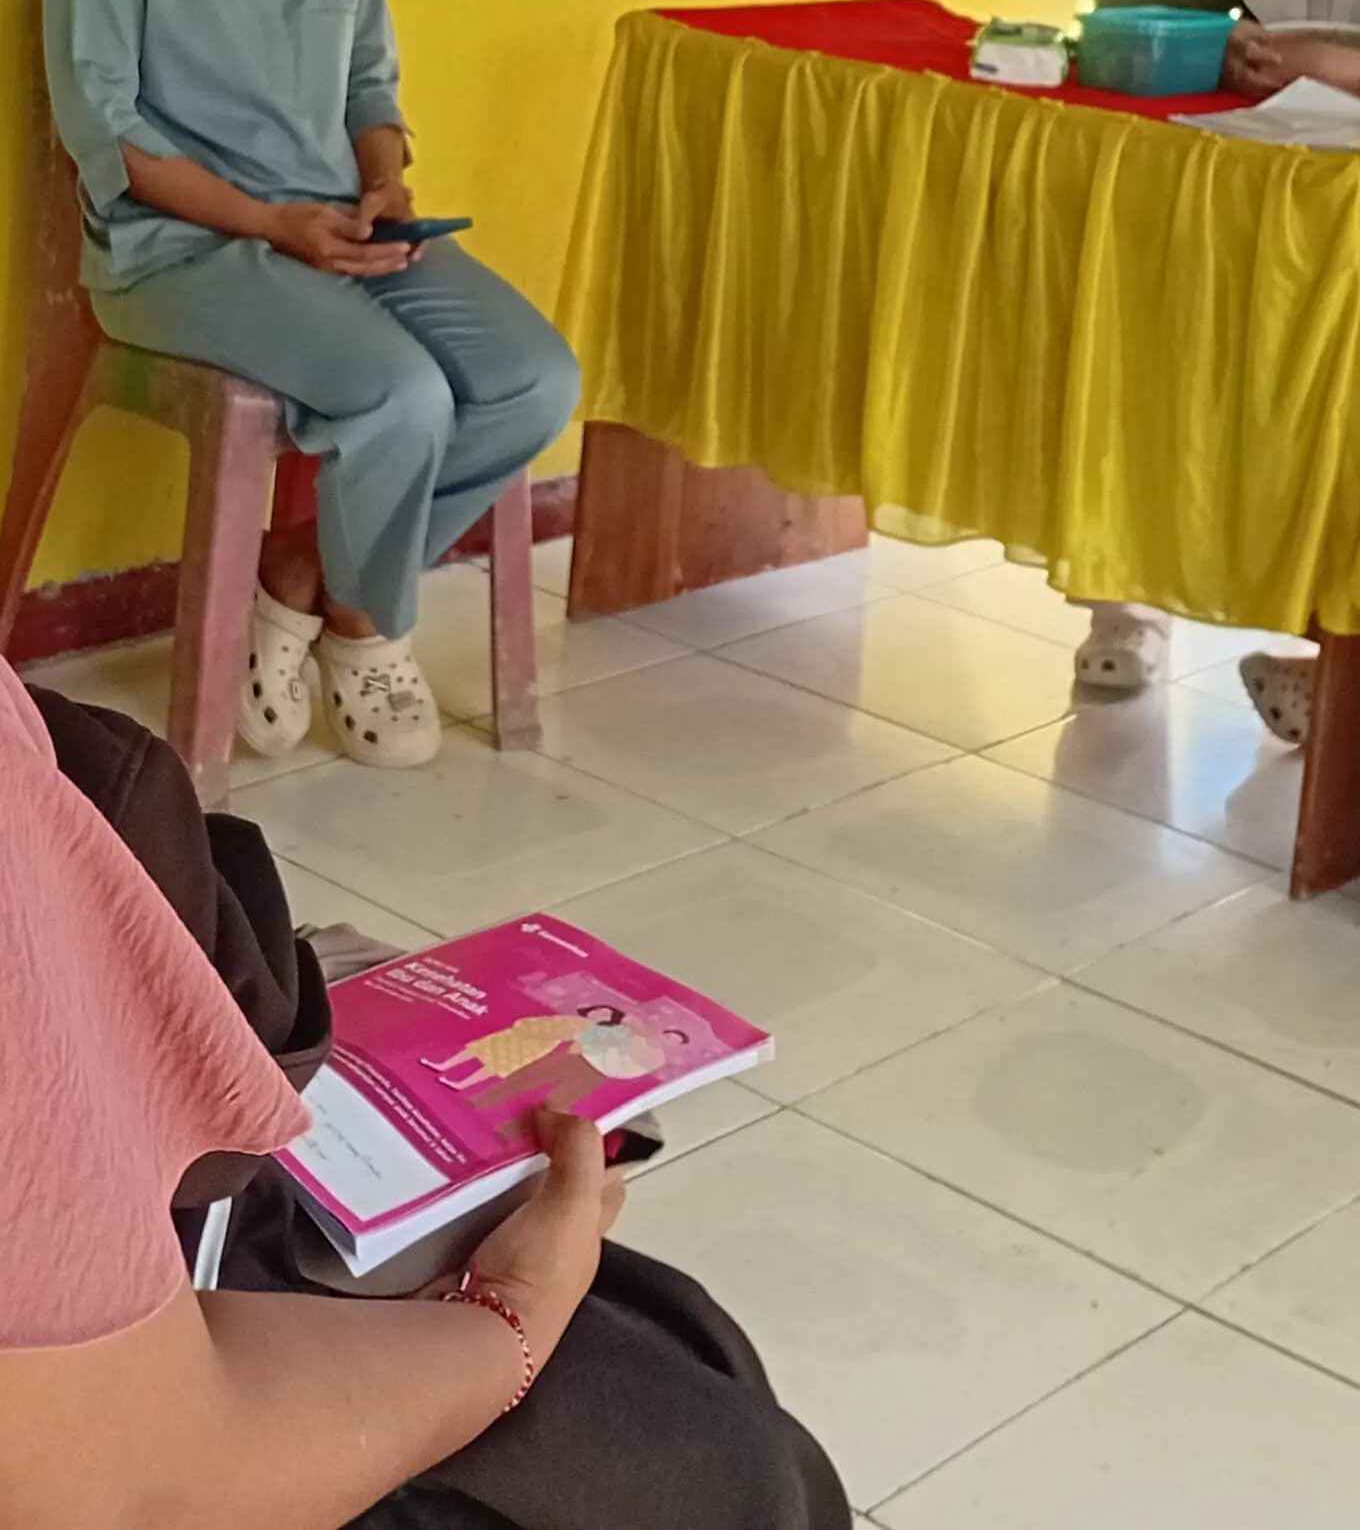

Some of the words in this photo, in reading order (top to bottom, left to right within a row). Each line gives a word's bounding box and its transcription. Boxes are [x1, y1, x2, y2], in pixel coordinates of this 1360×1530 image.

[404, 961, 487, 999] Kesehatan
[413, 979, 446, 995] dan
[443, 992, 488, 1016] Anak
